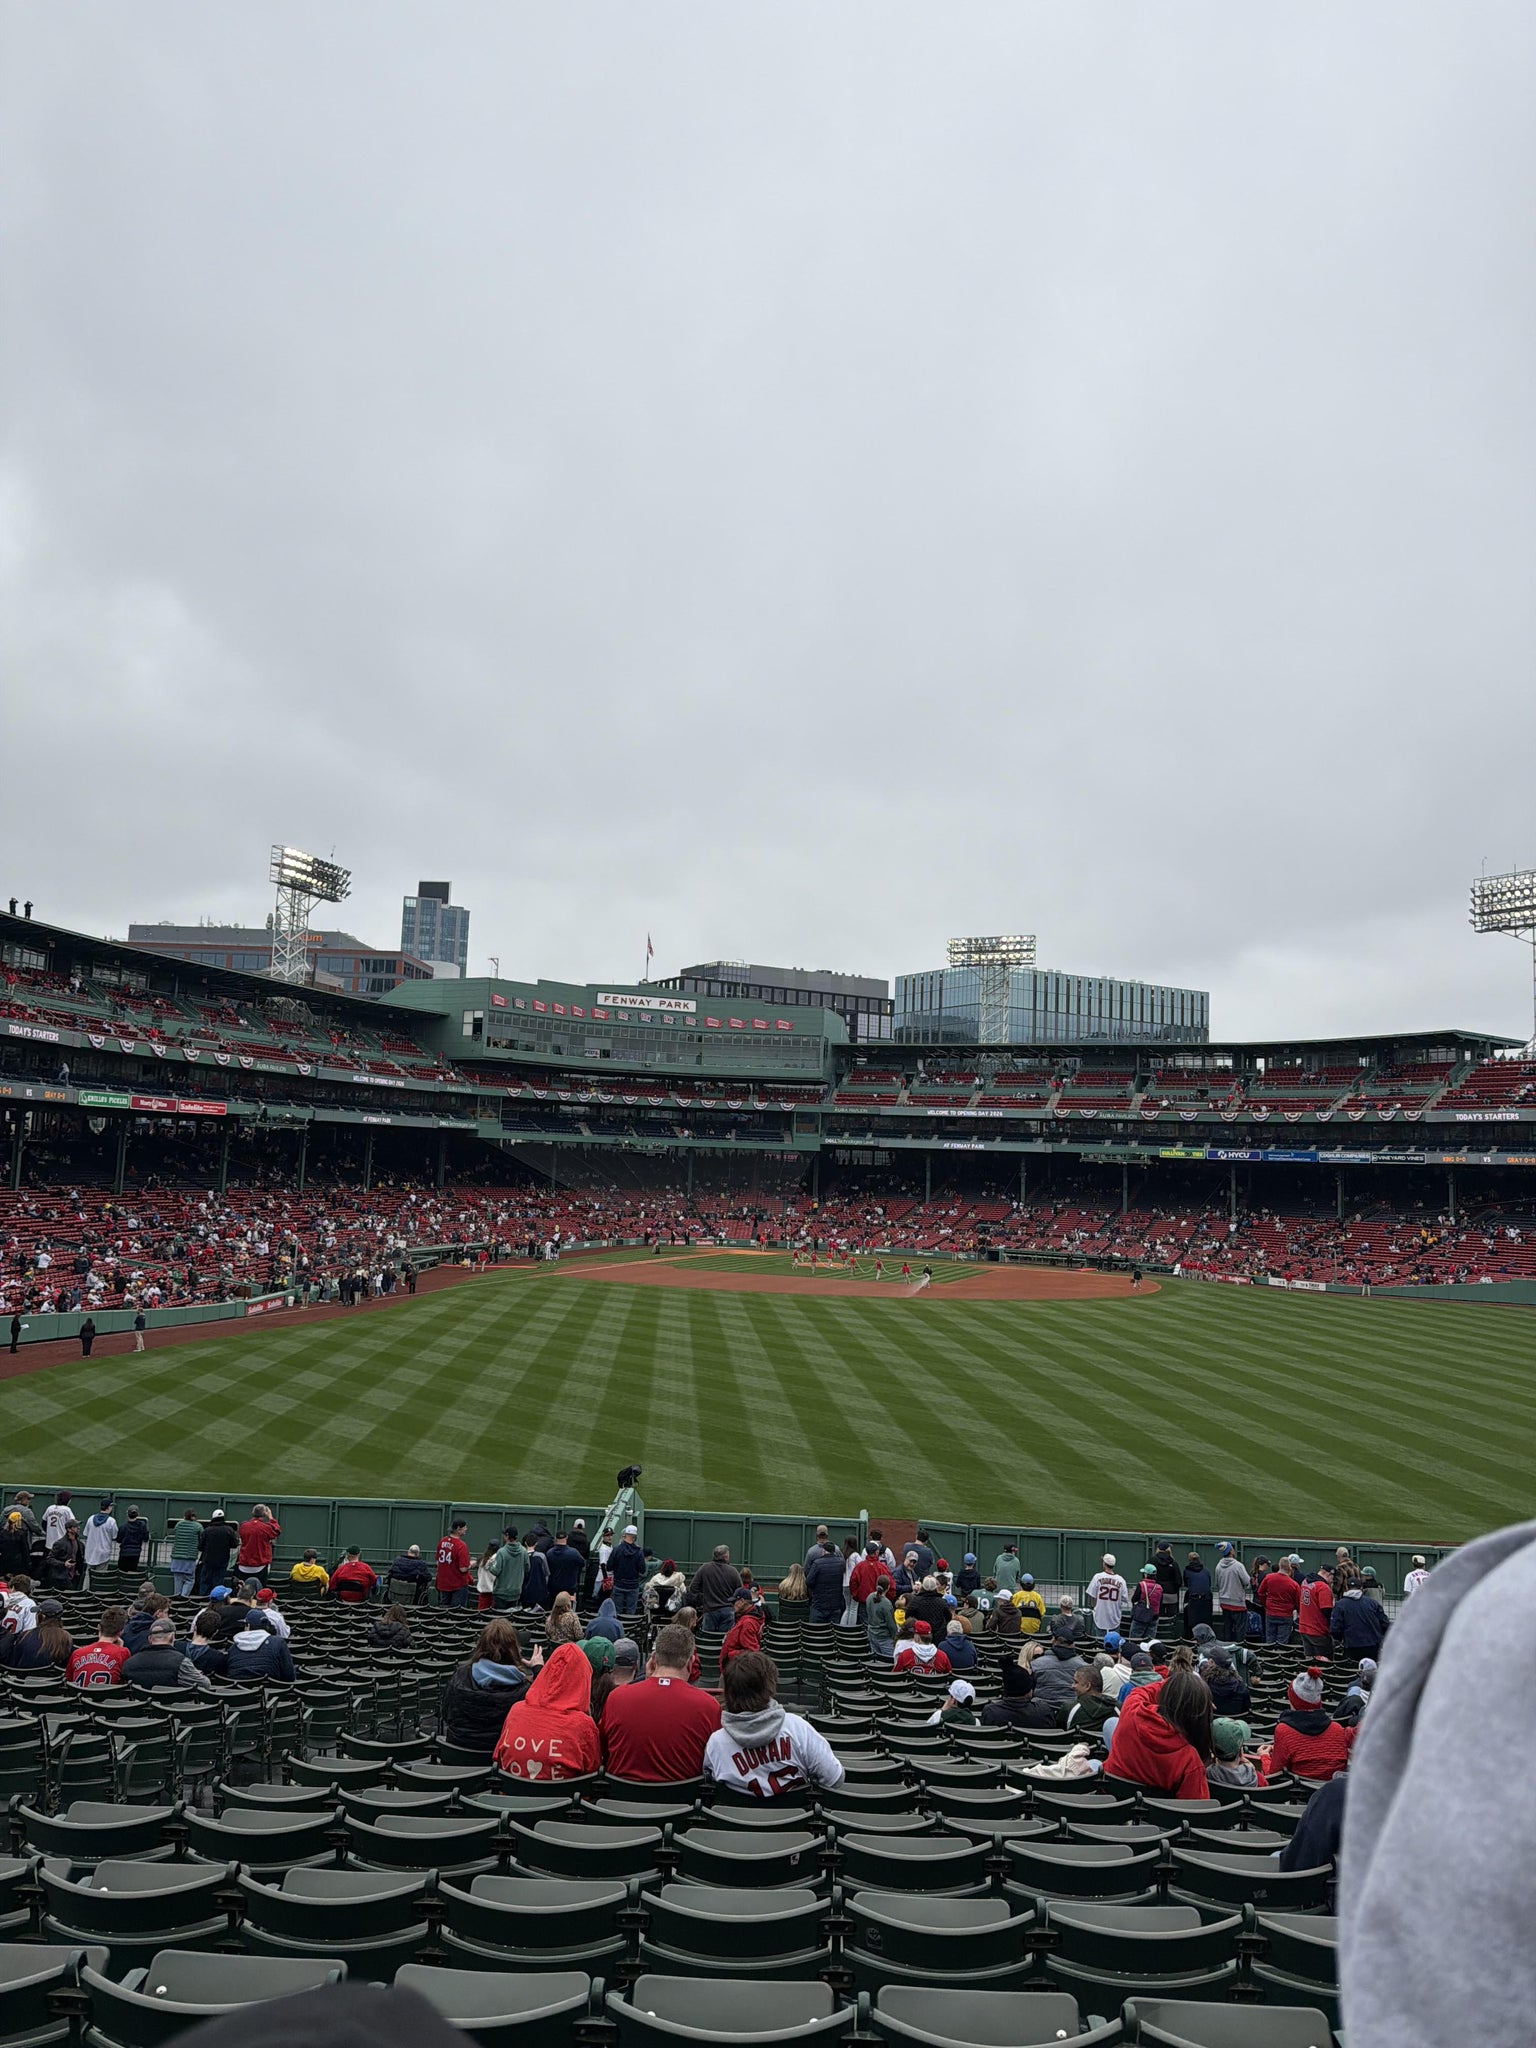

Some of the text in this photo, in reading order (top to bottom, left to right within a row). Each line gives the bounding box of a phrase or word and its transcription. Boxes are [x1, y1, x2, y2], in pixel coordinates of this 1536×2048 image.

[604, 995, 690, 1010] FENWAY PARK
[8, 1024, 59, 1041] TODAY'S STARTERS
[1485, 1112, 1520, 1120] STARTERS
[1228, 1151, 1250, 1159] HYCU
[50, 1516, 58, 1528] 2
[438, 1549, 452, 1565] 34
[1098, 1586, 1120, 1602] 20
[502, 1728, 564, 1757] LOVE
[731, 1736, 792, 1777] DURAN
